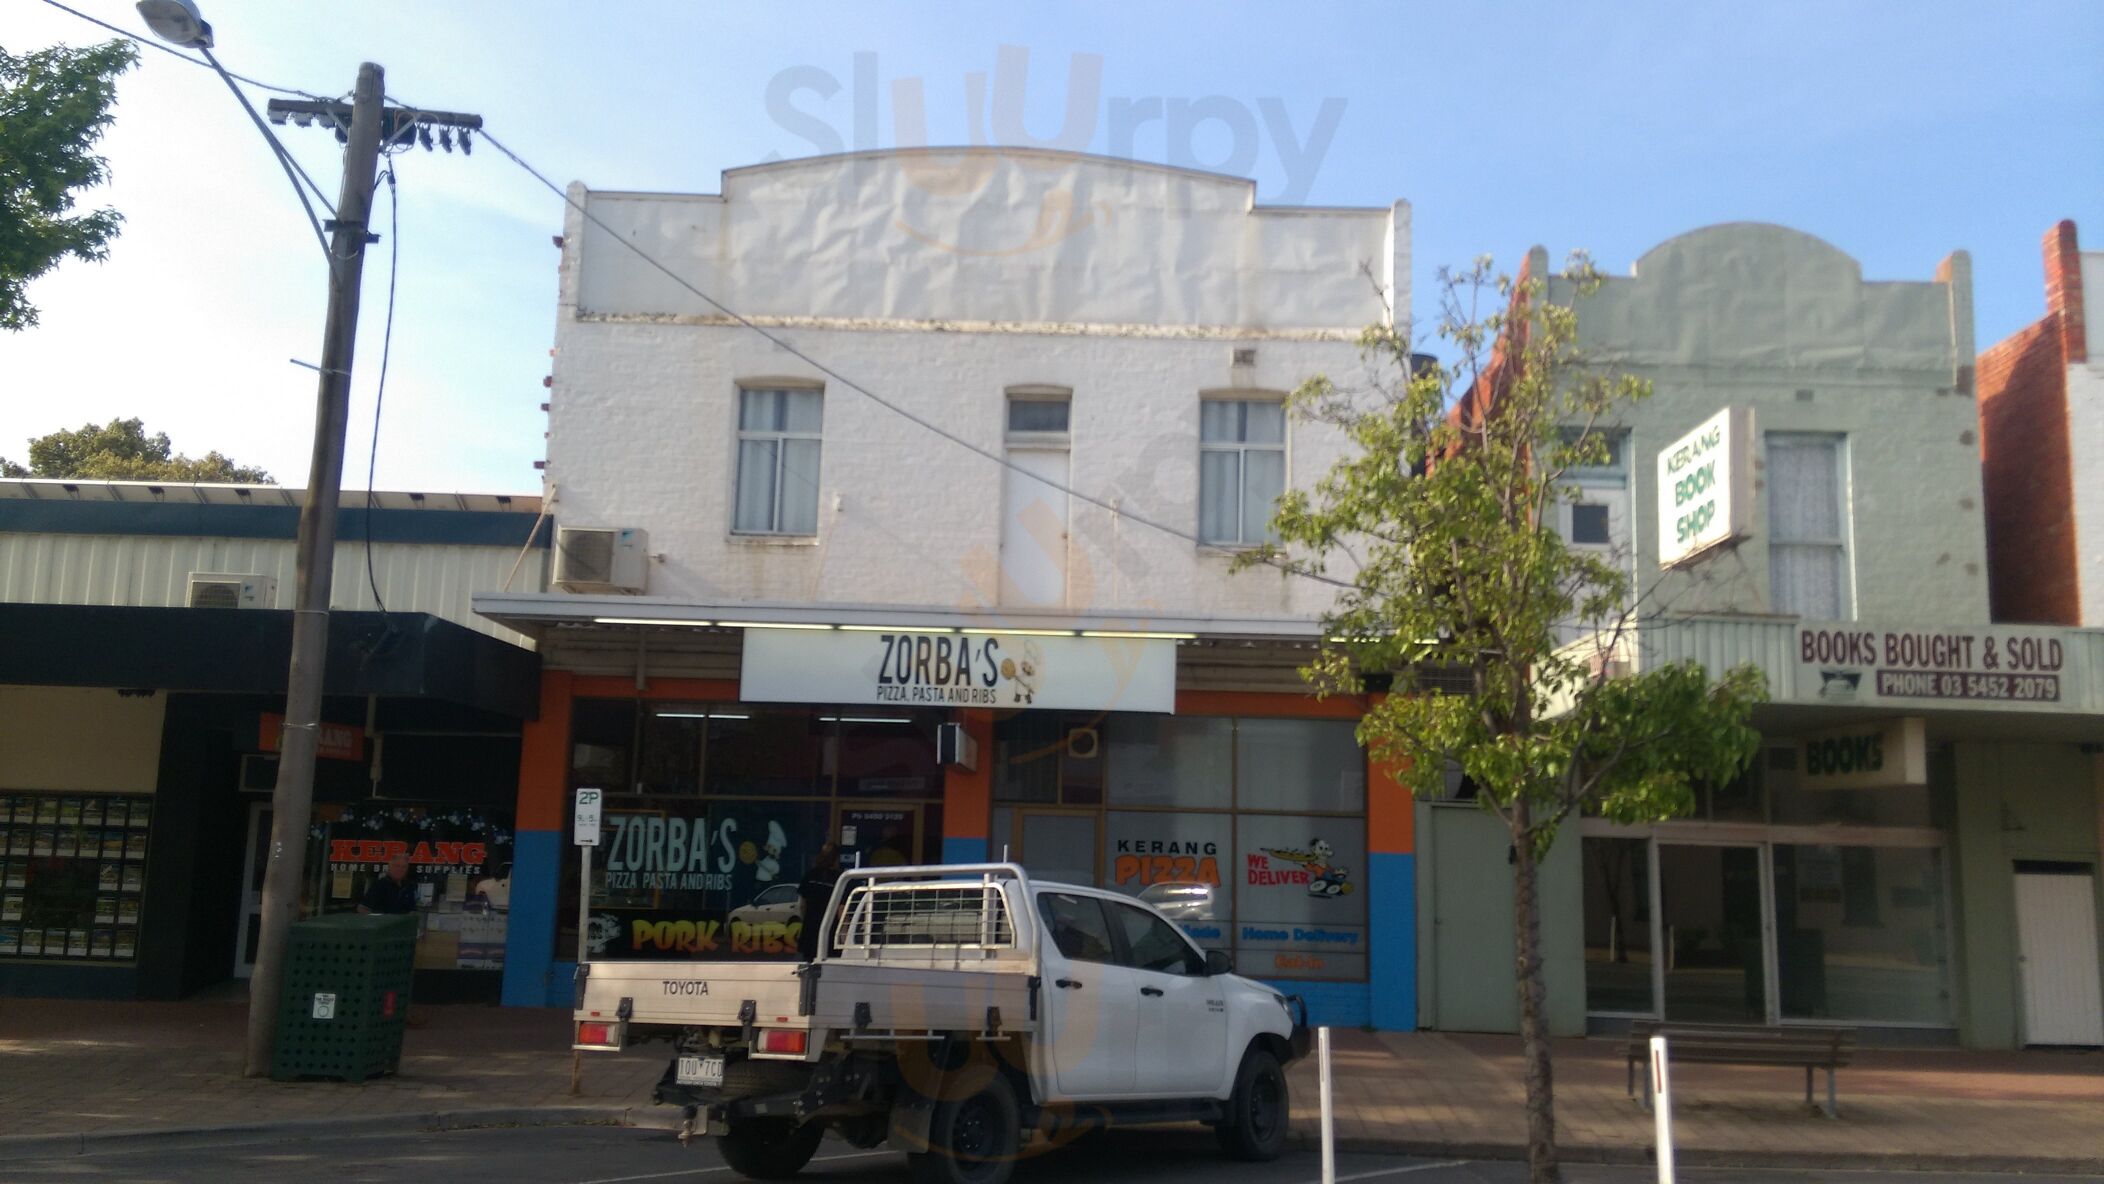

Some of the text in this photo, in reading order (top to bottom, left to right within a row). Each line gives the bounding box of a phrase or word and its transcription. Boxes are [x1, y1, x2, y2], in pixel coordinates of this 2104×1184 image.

[1667, 424, 1721, 476] KERANG
[1675, 460, 1716, 507] BOOK
[1676, 500, 1716, 543] SHOP
[879, 634, 999, 687] ZORBA'S
[1801, 630, 2063, 671] BOOKS BOUGHT & SOLD
[913, 686, 944, 703] PASTA
[948, 688, 970, 703] AND
[972, 688, 997, 704] RIBS
[1882, 674, 2058, 699] PHONE 03 5452 2079
[1806, 733, 1884, 776] BOOKS
[579, 791, 599, 805] 2P
[329, 839, 488, 864] KERANG
[606, 816, 738, 872] ZORBA'S
[1117, 839, 1218, 855] KERANG
[330, 863, 366, 872] HOME
[416, 864, 481, 874] SUPPLIES
[1114, 855, 1222, 889] PIZZA
[1247, 854, 1269, 869] WE
[642, 871, 678, 890] PASTA
[680, 872, 703, 890] AND
[705, 872, 732, 891] RIBS
[1247, 868, 1310, 887] DELIVER
[631, 919, 720, 953] PORK
[730, 920, 803, 955] RIBS
[1242, 926, 1360, 945] Home Delivery
[662, 980, 710, 996] TOYOTA
